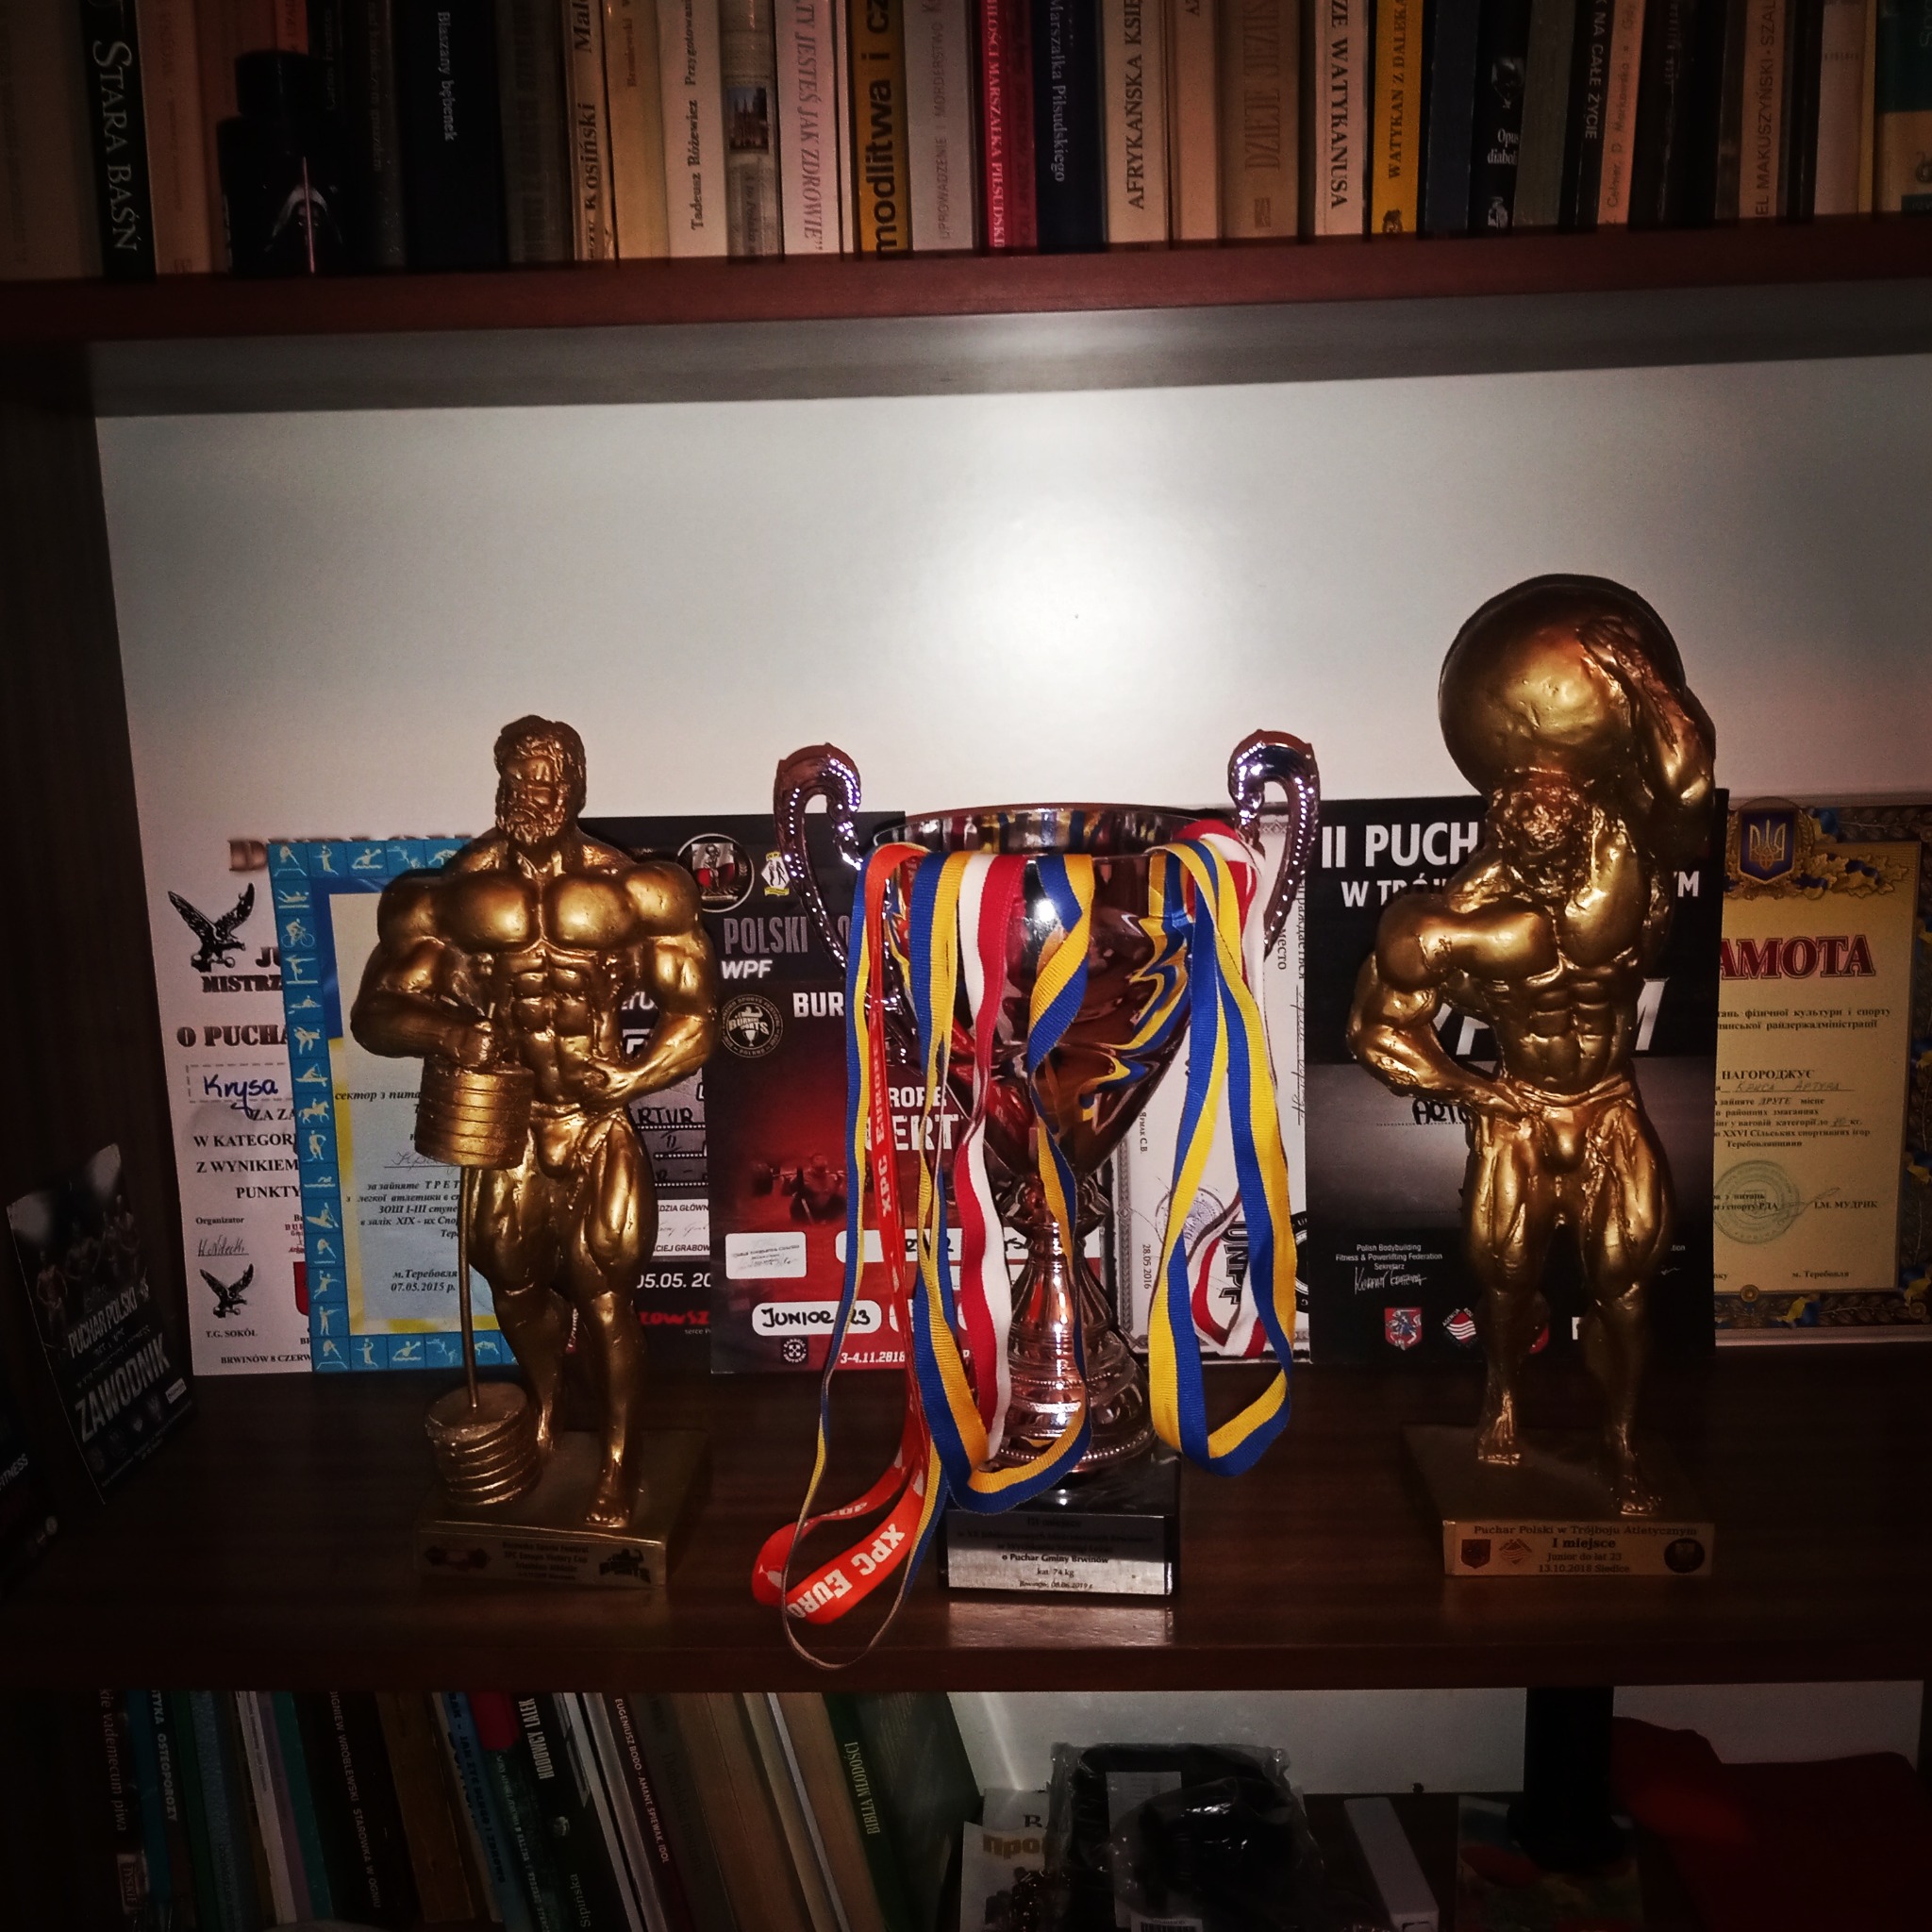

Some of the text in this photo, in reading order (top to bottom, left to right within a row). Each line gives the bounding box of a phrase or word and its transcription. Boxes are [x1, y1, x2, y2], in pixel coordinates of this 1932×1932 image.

[436, 9, 459, 143] Blaszany bębenek
[794, 31, 822, 103] JESTEŚ
[1584, 10, 1607, 141] NA CAŁE ŻYCIE
[988, 60, 1003, 157] MARSZAŁKA
[797, 106, 820, 144] JAK
[1050, 84, 1069, 183] Piłsudskiego
[1124, 54, 1144, 210] AFRYKAŃSKA
[1330, 38, 1349, 209] WATYKANUSA
[1387, 74, 1406, 180] WATYKAN Z
[1754, 58, 1775, 190] MAKUSZYŃSKI
[92, 40, 142, 253] STARA BAŚŃ
[861, 52, 897, 260] modlitwa i
[685, 99, 705, 231] Tadeusz Różewicz
[935, 137, 952, 241] UPROWADZENIE
[1321, 825, 1347, 869] II
[1341, 880, 1369, 908] W
[723, 915, 809, 956] POLSKI
[720, 958, 774, 980] WPF
[1792, 1007, 1843, 1019] культури
[1856, 1007, 1891, 1019] спорту
[175, 1025, 197, 1047] O
[202, 1073, 279, 1122] Krysa
[334, 1091, 378, 1103] сектор
[1799, 1097, 1826, 1107] місце
[192, 1135, 209, 1148] W
[195, 1158, 300, 1174] Z WYNIKIEM
[236, 1185, 301, 1199] PUNKTY
[390, 1191, 441, 1203] атлетики
[1833, 1199, 1880, 1210] МУДРИК
[194, 1216, 245, 1225] Organizator
[366, 1217, 392, 1226] залік
[377, 1204, 405, 1215] ЗОШ
[658, 1204, 678, 1212] DZIA
[654, 1244, 675, 1253] CIEJ
[1335, 1251, 1443, 1262] Fitness & Powerlifting Federation
[1356, 1242, 1422, 1253] Polish Bodybuilding
[1141, 1243, 1153, 1290] 28.05.2016
[1373, 1261, 1406, 1271] Sekretarz
[390, 1281, 445, 1292] 07.05.2015
[67, 1285, 139, 1359] PUCHAR POLSKI
[225, 1327, 257, 1339] SOKÓŁ
[220, 1354, 270, 1365] BRWINÓW
[74, 1331, 172, 1443] ZAWODNIK
[1473, 1524, 1697, 1537] Puchar Polski w Trójboju Atletycznym
[1561, 1537, 1617, 1550] miejsce
[850, 1523, 906, 1576] XPC
[1009, 1553, 1040, 1562] Puchar
[1041, 1554, 1070, 1565] Gminy
[1546, 1551, 1577, 1562] Junior
[1578, 1551, 1591, 1561] do
[1592, 1551, 1607, 1561] lat
[1538, 1563, 1592, 1574] 13.10.2018
[101, 1712, 129, 1832] vademecum piwa
[156, 1732, 178, 1823] OSTEOPOROZY
[613, 1697, 671, 1864] EUGENIUSZ BODO IDOL
[843, 1740, 881, 1836] BIBLIA MŁODOŚCI
[337, 1733, 359, 1803] WRÓBLEWSKI
[367, 1877, 382, 1909] OGNIU
